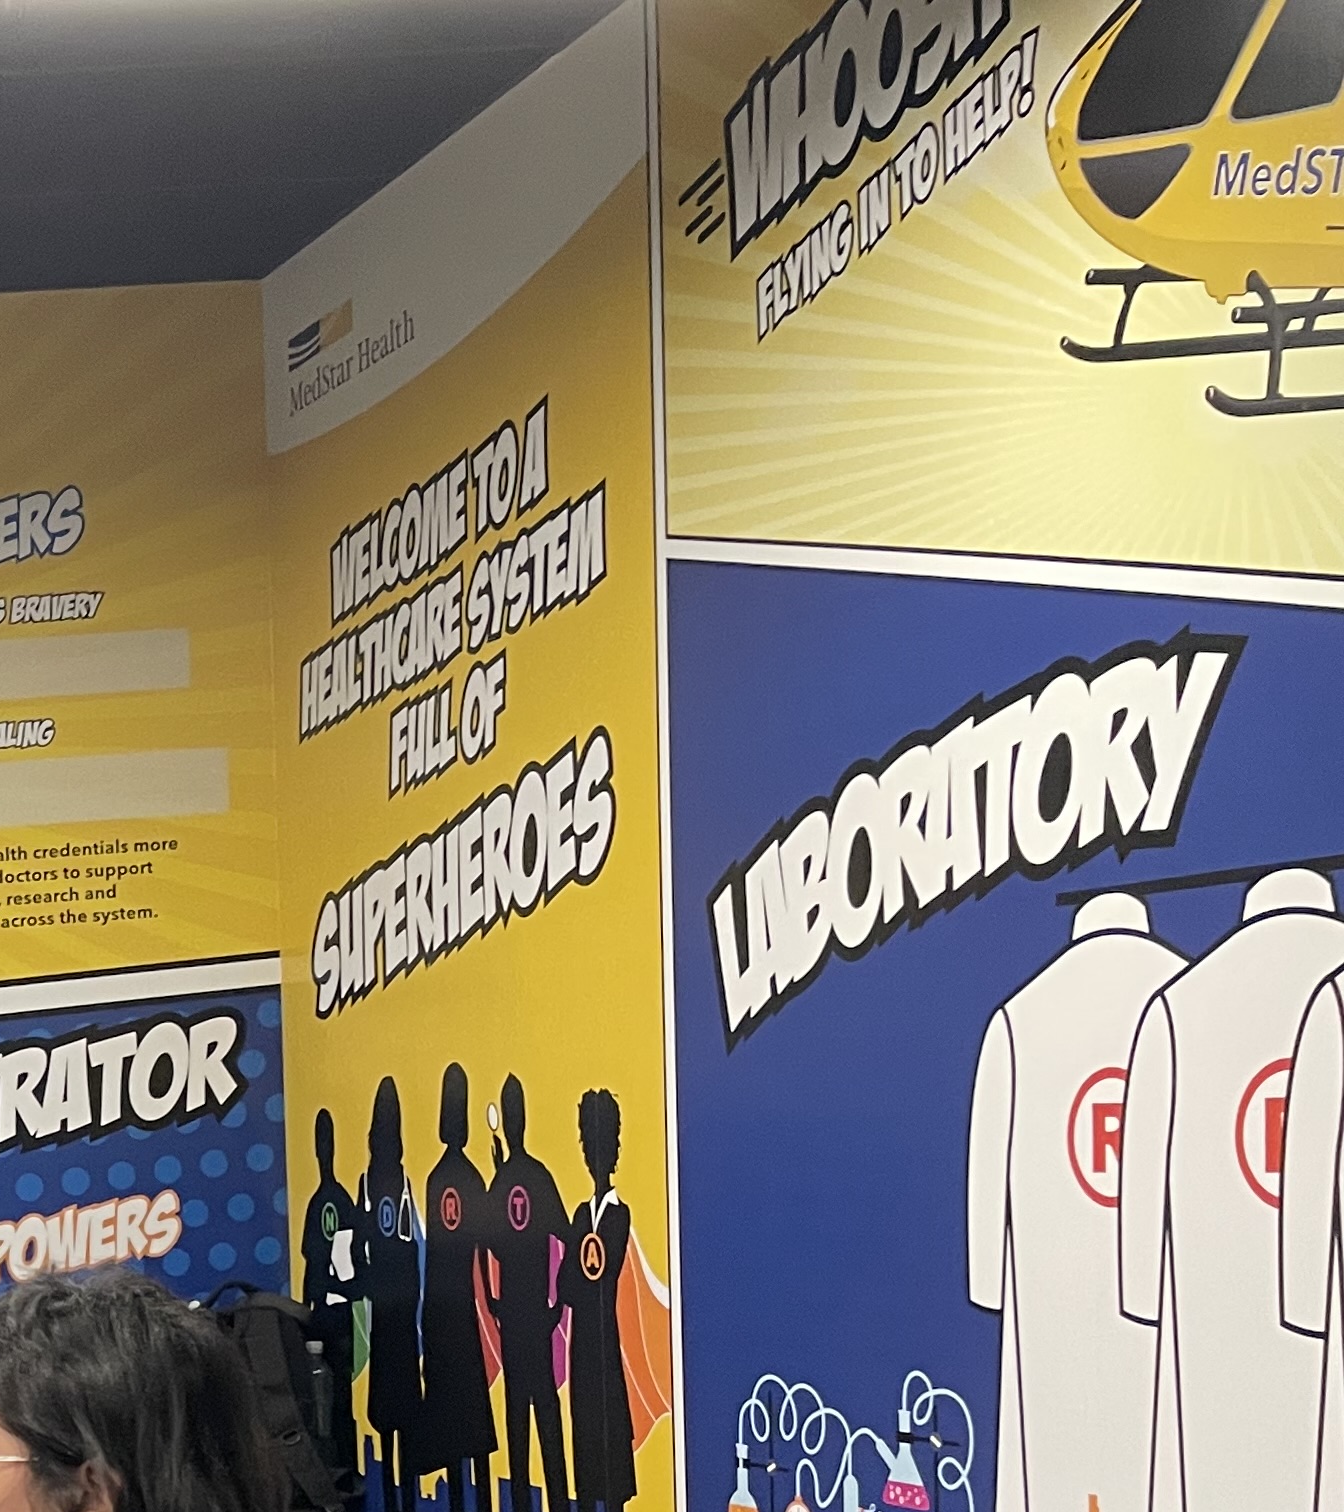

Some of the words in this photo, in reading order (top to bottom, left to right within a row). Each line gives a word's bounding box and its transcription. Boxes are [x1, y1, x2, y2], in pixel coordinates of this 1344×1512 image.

[757, 200, 854, 343] FLYING
[858, 163, 892, 257] IN
[893, 121, 940, 220] TO
[942, 27, 1040, 184] HELP!
[289, 356, 353, 417] MedStar
[357, 310, 414, 373] Health
[331, 450, 468, 626] WELCOME
[471, 420, 518, 541] TO
[518, 396, 549, 518] A
[9, 591, 104, 625] BRAVERY
[300, 575, 462, 742] HEALTHCARE
[466, 480, 607, 652] SYSTEM
[389, 685, 456, 799] FULL
[459, 652, 506, 763] OF
[32, 839, 129, 860] credentials
[133, 837, 179, 852] more
[711, 642, 1234, 1038] LABORATORY
[62, 865, 81, 880] to
[85, 860, 154, 881] support
[313, 726, 613, 1018] SUPERHEROES
[6, 886, 80, 907] research
[84, 884, 117, 900] and
[0, 913, 55, 930] across
[59, 908, 88, 925] the
[92, 905, 160, 927] system.
[325, 1213, 336, 1230] N
[381, 1206, 392, 1227] D
[445, 1198, 456, 1219] R
[512, 1198, 525, 1219] T
[586, 1242, 600, 1268] A
